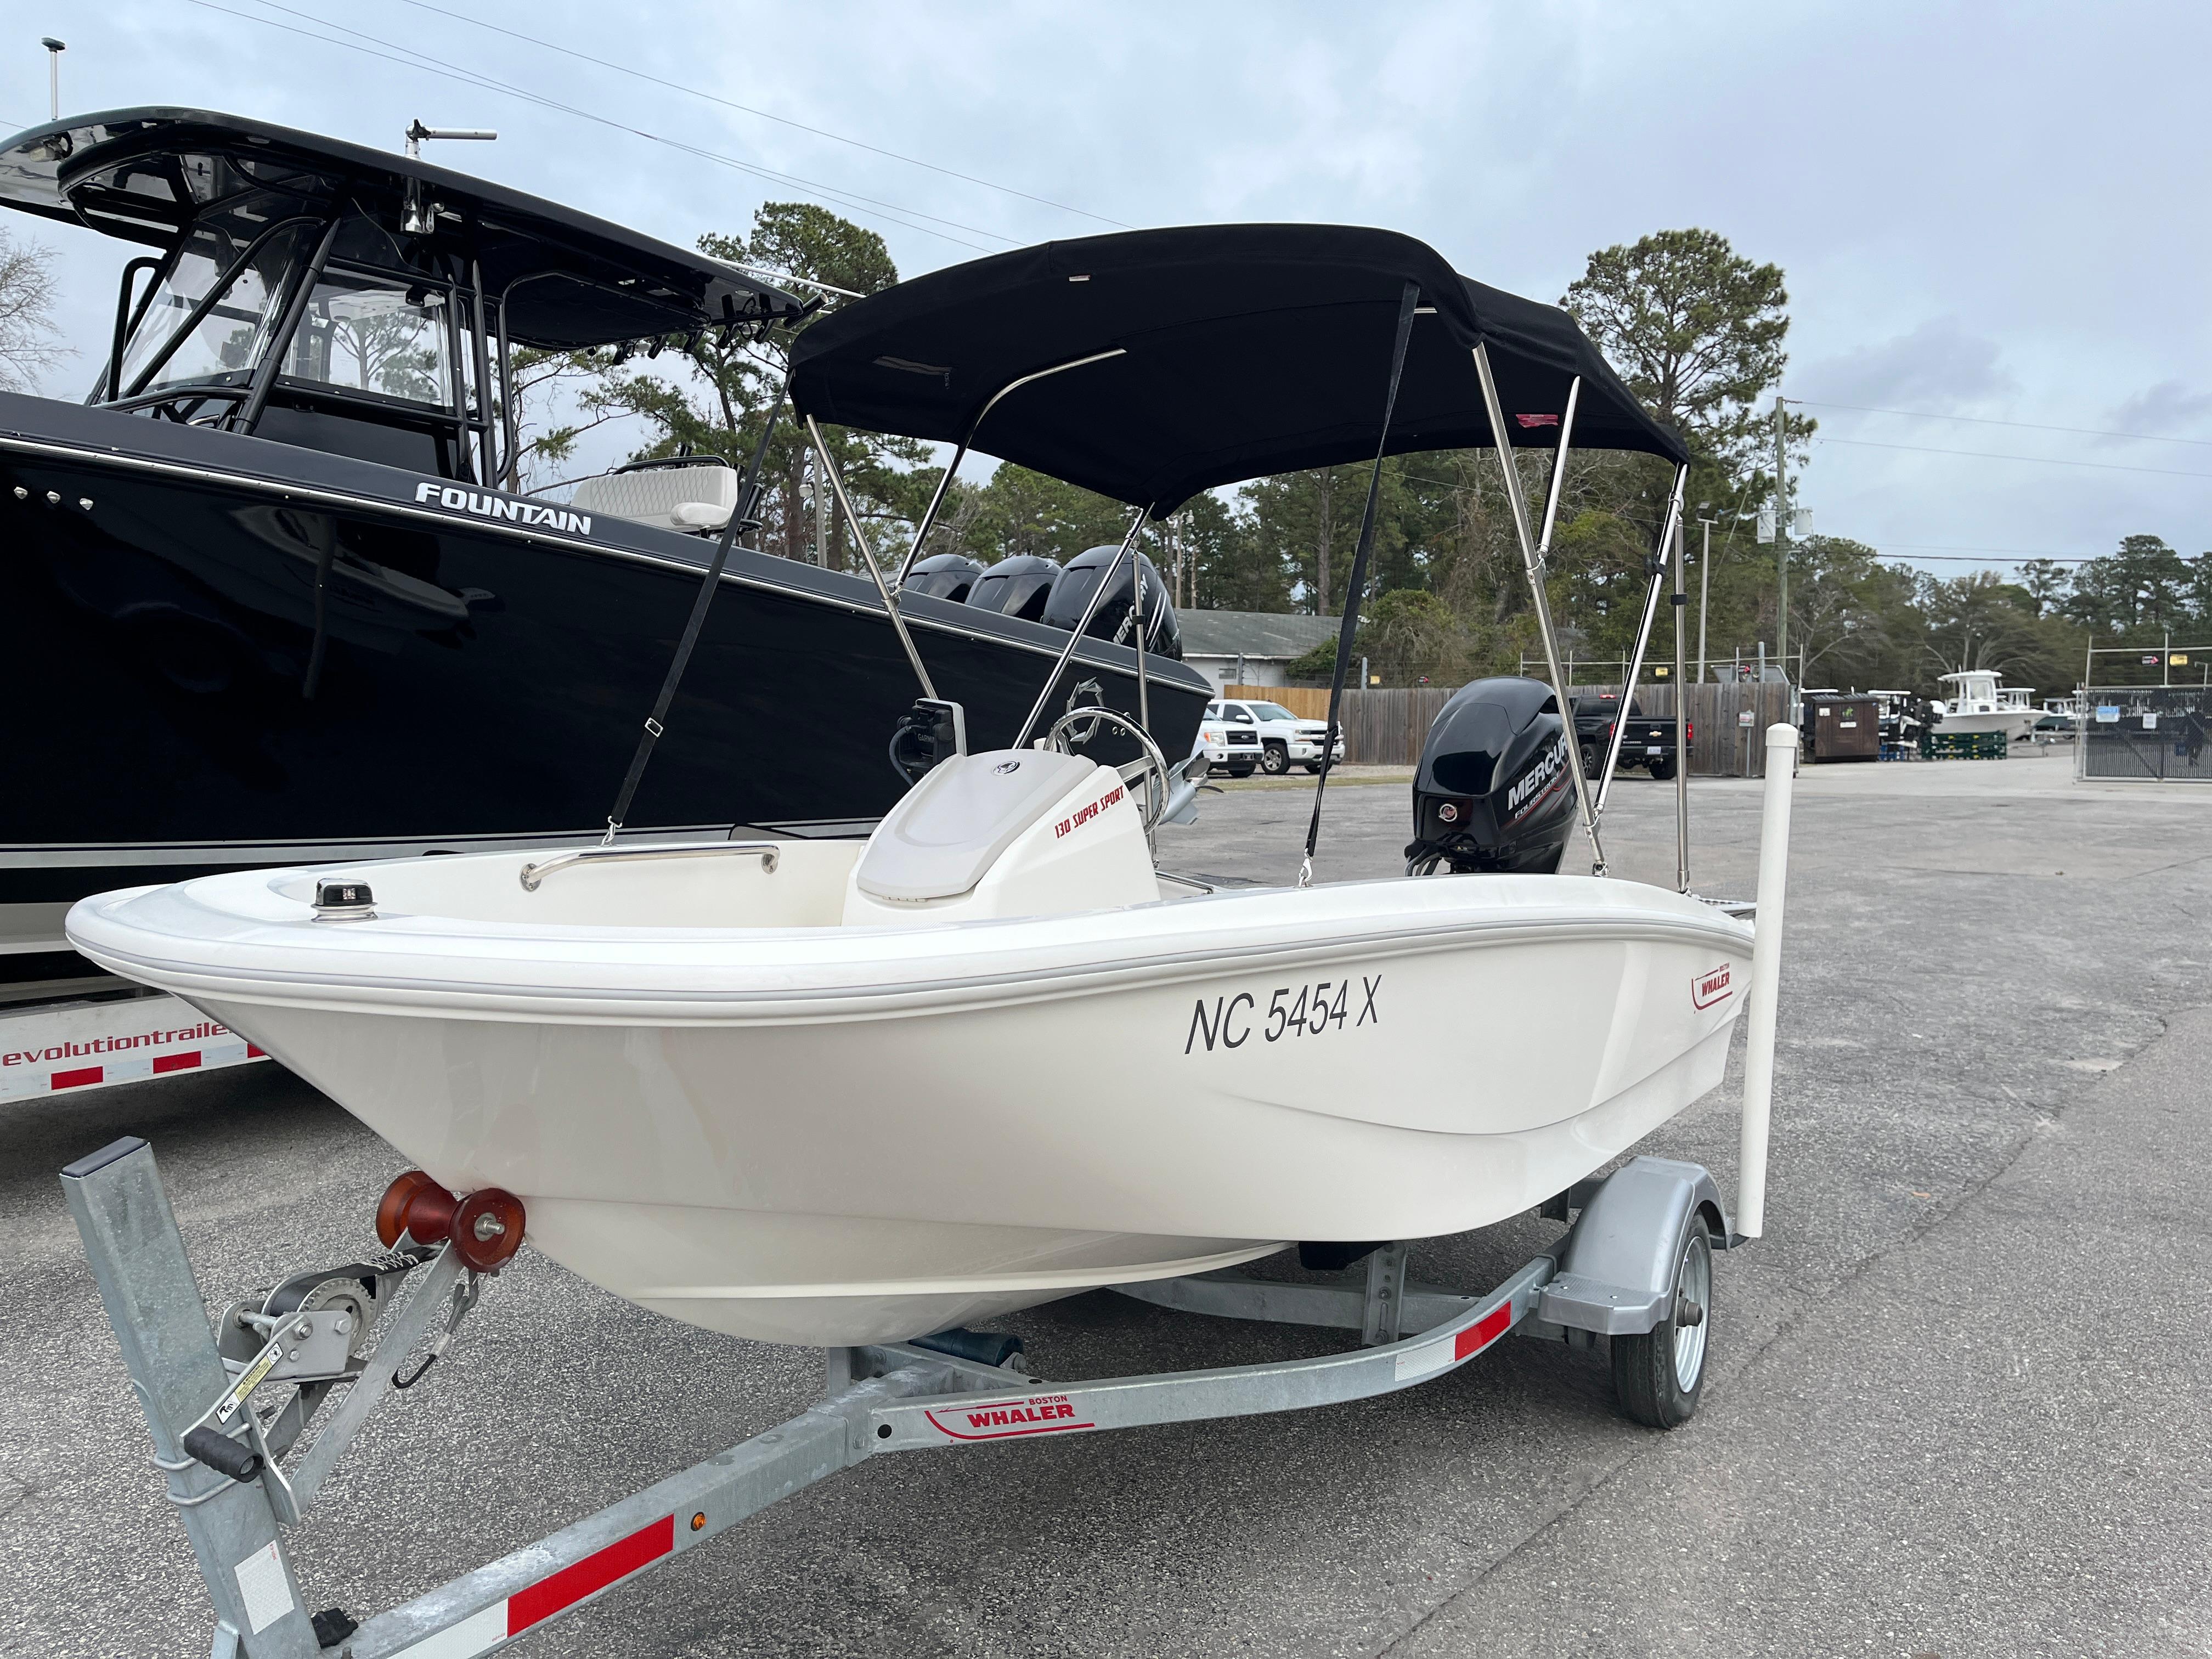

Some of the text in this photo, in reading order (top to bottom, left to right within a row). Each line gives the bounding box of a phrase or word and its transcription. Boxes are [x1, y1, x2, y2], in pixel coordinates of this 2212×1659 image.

[415, 482, 591, 535] FOUNTAIN
[1113, 573, 1148, 645] ERCRY
[1508, 732, 1568, 810] MERCUR
[1055, 785, 1124, 839] 130 SUPER SPORT
[1702, 972, 1729, 997] WHALER
[1184, 974, 1382, 1054] NC 5454 X
[2, 1022, 233, 1066] evolutiontraile
[967, 1404, 1075, 1427] WHALER
[1029, 1395, 1068, 1405] BOSTON
